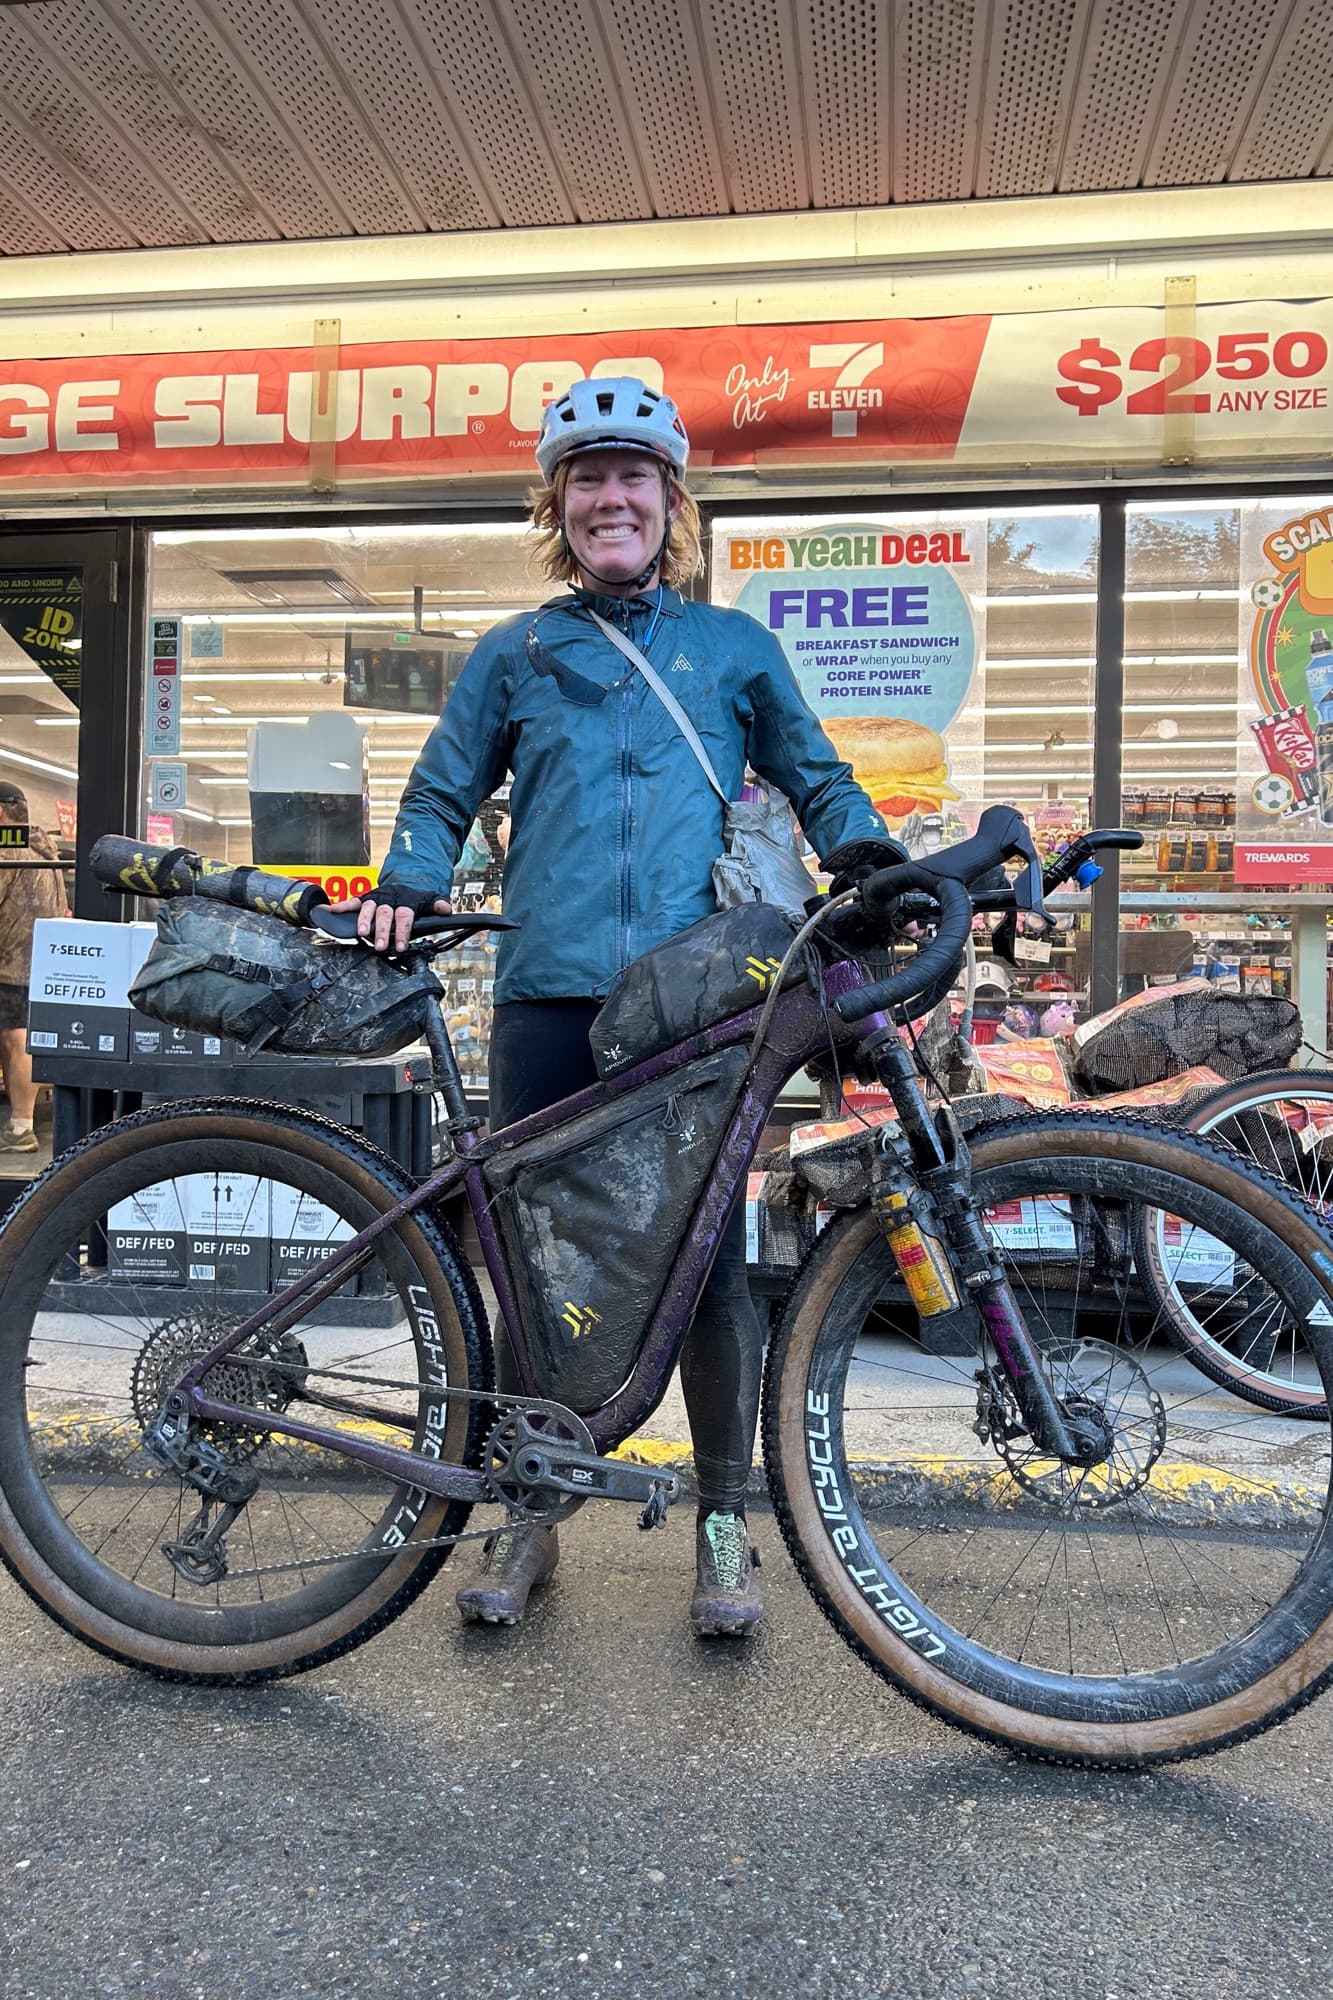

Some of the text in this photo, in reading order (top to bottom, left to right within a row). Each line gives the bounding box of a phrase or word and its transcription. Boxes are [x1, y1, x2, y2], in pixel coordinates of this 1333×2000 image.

[725, 356, 795, 401] Only
[809, 342, 884, 437] 7
[733, 393, 776, 429] At
[1216, 388, 1328, 413] ANY SIZE
[11, 579, 30, 588] AND
[32, 578, 63, 588] UNDER
[40, 606, 74, 635] ID
[769, 586, 929, 629] FREE
[795, 636, 959, 651] BREAKFAST SANDWICH
[802, 653, 952, 666] or WRAP when you buy any
[827, 669, 921, 681] CORE POWER
[820, 685, 932, 697] PROTEIN SHAKE
[807, 1389, 859, 1559] BICYCLE
[847, 1564, 947, 1659] LIGHT
